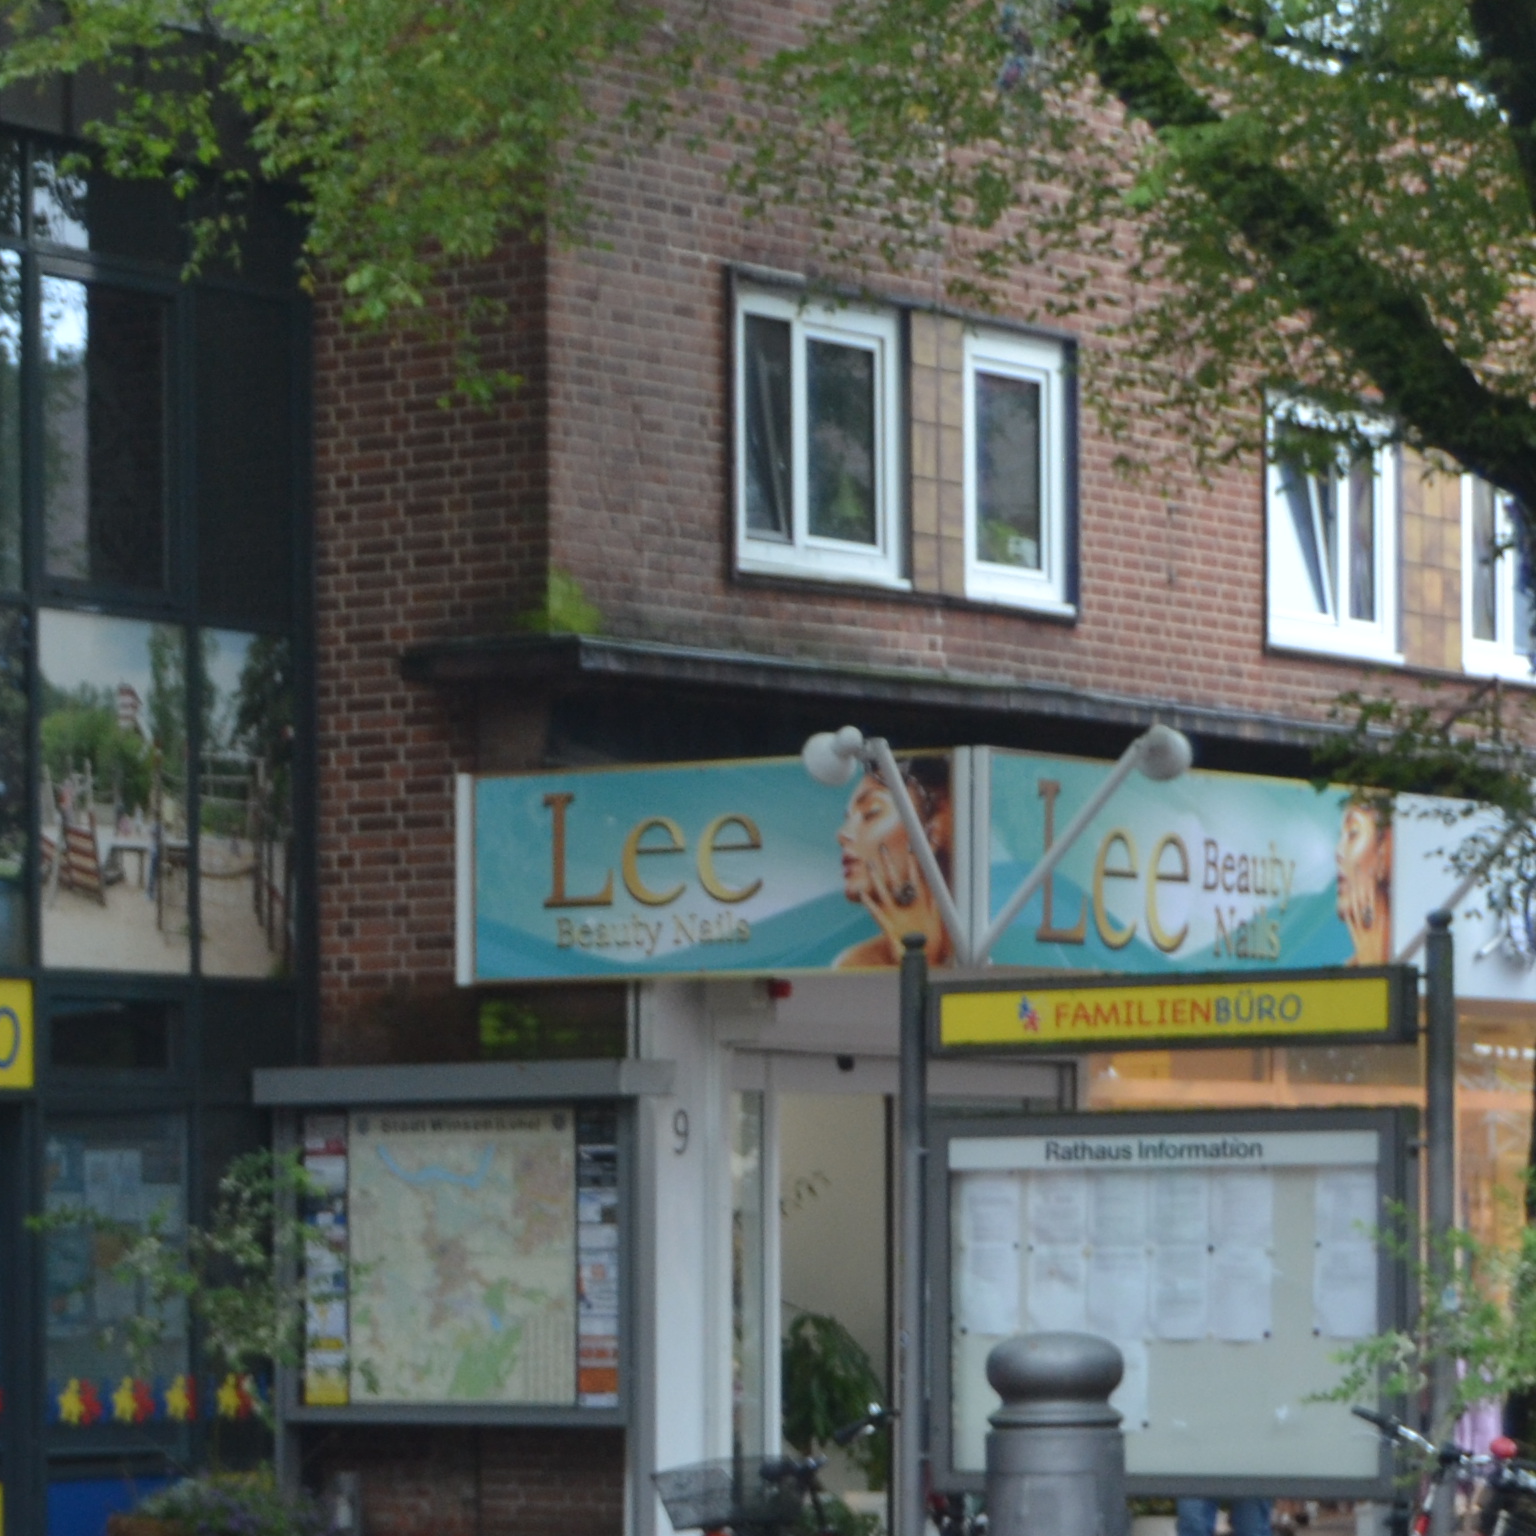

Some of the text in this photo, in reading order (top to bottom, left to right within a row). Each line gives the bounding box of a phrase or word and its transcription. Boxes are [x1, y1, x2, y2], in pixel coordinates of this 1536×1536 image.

[543, 792, 763, 909] Lee
[1035, 779, 1190, 954] Lee
[1203, 839, 1295, 913] Beauty
[557, 911, 752, 956] Beauty Nails
[1213, 905, 1281, 960] Nails
[1055, 988, 1303, 1028] FAMILIENBÜRO
[671, 1108, 690, 1155] 9
[1045, 1136, 1263, 1162] Rathaus Information
